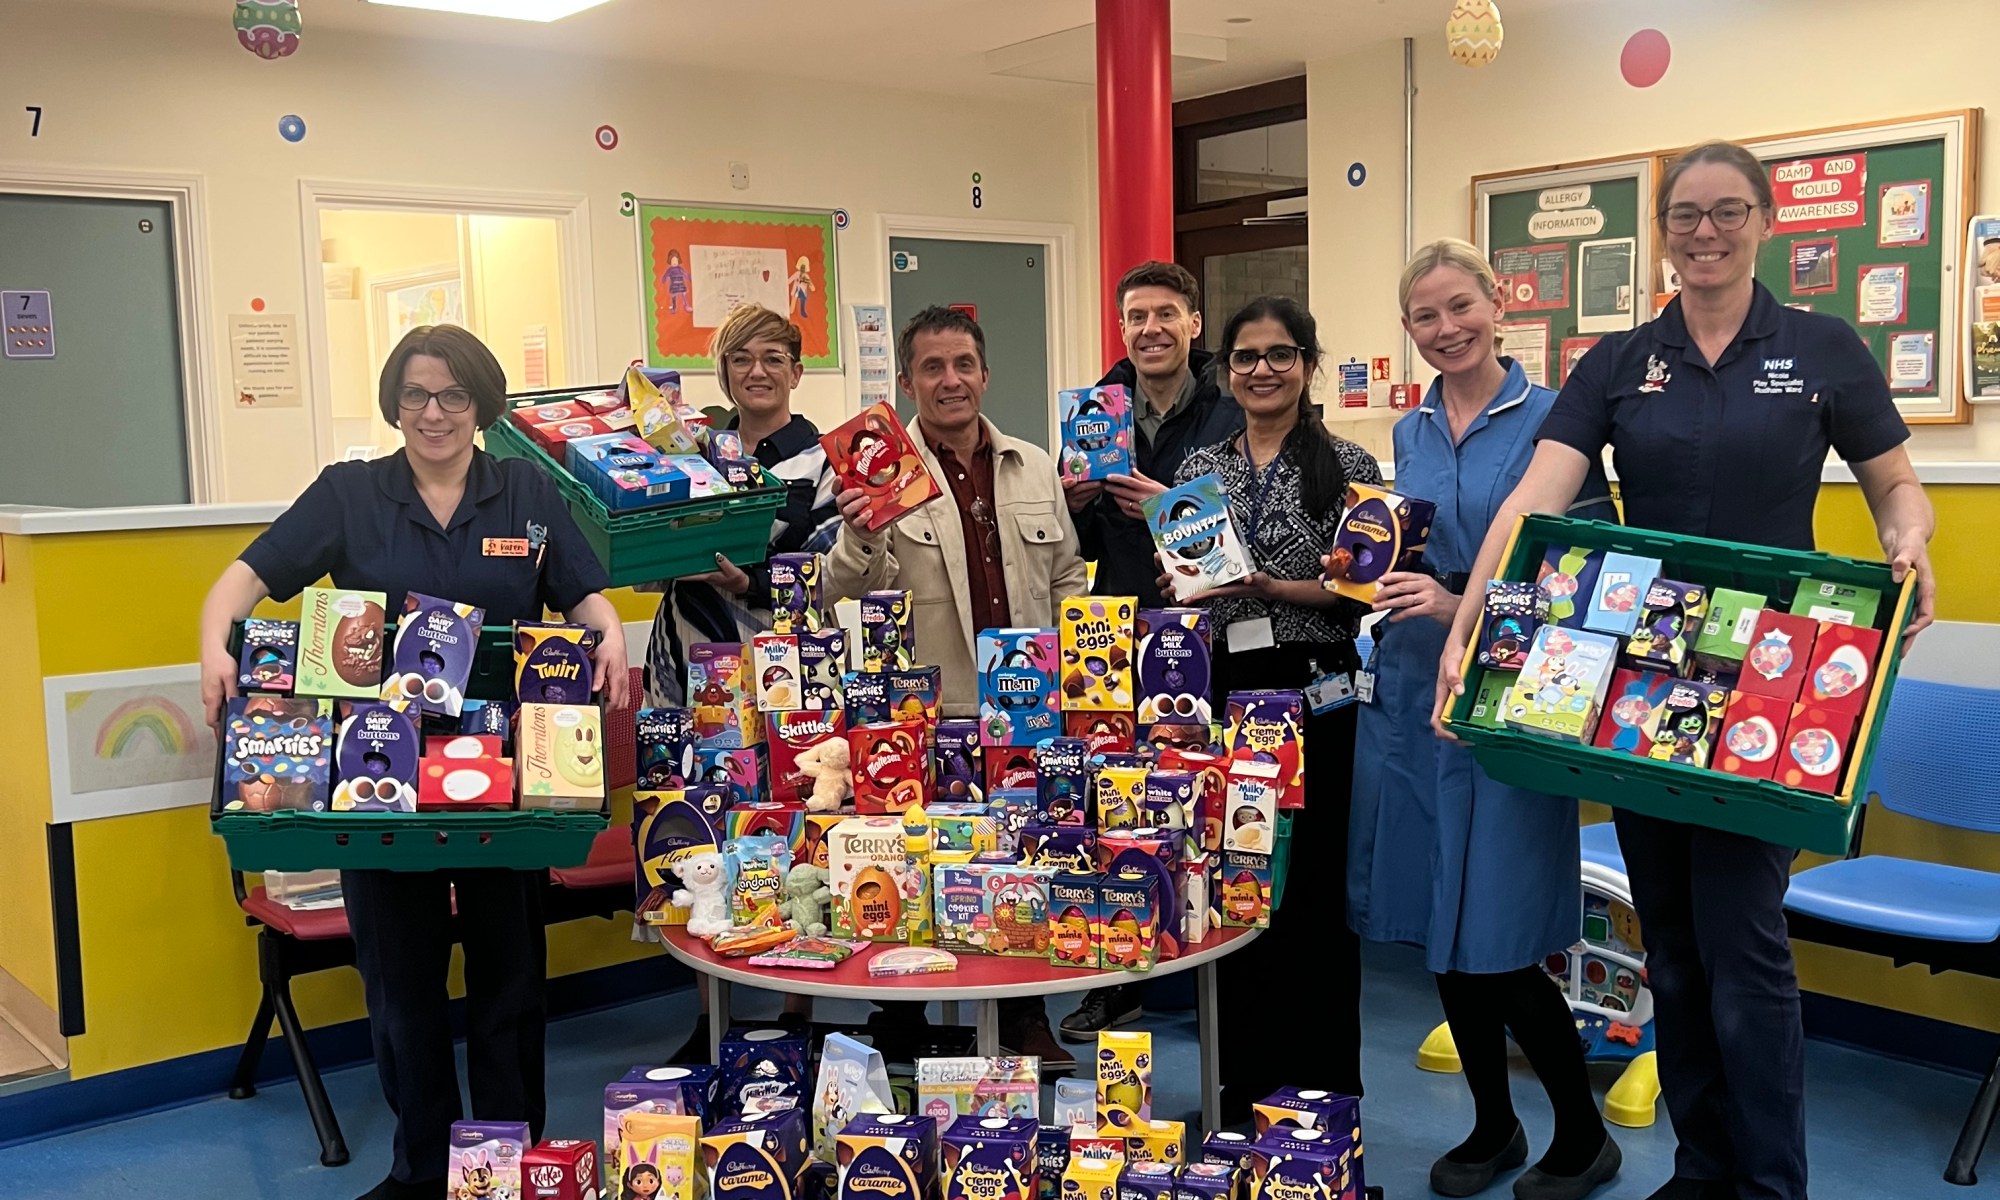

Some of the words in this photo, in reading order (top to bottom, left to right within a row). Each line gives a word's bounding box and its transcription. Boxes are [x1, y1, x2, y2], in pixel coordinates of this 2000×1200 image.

[26, 106, 42, 136] 7
[1777, 167, 1812, 180] DAMP
[1826, 159, 1854, 174] AND
[1795, 182, 1840, 196] MOULD
[973, 186, 981, 208] 8
[1545, 192, 1583, 205] ALLERGY
[1780, 202, 1856, 219] AWARENESS
[1533, 216, 1597, 230] INFORMATION
[20, 296, 30, 310] 7
[1764, 359, 1793, 370] NHS
[856, 439, 887, 476] Maltesers
[1162, 514, 1218, 545] BOUNTY
[1349, 520, 1388, 537] Caramel
[772, 574, 795, 584] Freddo
[1646, 594, 1674, 607] Freddo
[428, 616, 454, 628] DAIRY
[862, 613, 885, 623] Freddo
[302, 591, 329, 676] Thorntons
[428, 624, 449, 633] MILK
[1075, 619, 1111, 637] Mini
[418, 627, 458, 644] buttons
[1076, 632, 1116, 650] eggs
[1160, 635, 1185, 643] DAIRY
[764, 645, 789, 654] Milky
[1163, 641, 1182, 649] MILK
[542, 648, 569, 657] Cadbury
[769, 653, 784, 662] bar
[1155, 648, 1192, 657] buttons
[530, 659, 580, 680] Twirl
[1668, 694, 1698, 709] Freddo
[365, 717, 393, 726] DAIRY
[367, 723, 388, 731] MILK
[358, 730, 400, 740] buttons
[779, 720, 834, 740] Skittles
[1249, 728, 1281, 738] creme
[526, 705, 552, 779] Thorntons
[1090, 735, 1118, 753] altesers
[1254, 735, 1276, 745] egg
[867, 754, 902, 777] Maltesers
[1100, 788, 1121, 798] Mini
[1238, 783, 1265, 795] Milky
[1100, 797, 1123, 806] eggs
[1242, 793, 1261, 801] bar
[661, 851, 692, 866] Flak
[870, 854, 906, 862] ORANG
[991, 878, 1000, 888] 6
[863, 902, 889, 913] mini
[948, 905, 978, 913] COOKIES
[863, 911, 891, 922] eggs
[1058, 930, 1082, 939] minis
[1108, 934, 1133, 943] minis
[921, 1063, 979, 1074] CRYSTAL
[1100, 1060, 1123, 1071] Mini
[1101, 1070, 1127, 1080] eggs
[928, 1108, 948, 1116] 4000
[1083, 1150, 1112, 1159] Milky
[1129, 1149, 1152, 1159] Mini
[726, 1162, 756, 1172] Cadbury
[1040, 1156, 1064, 1167] TIES
[859, 1163, 891, 1175] Cadbury
[532, 1167, 562, 1187] KitKat
[721, 1174, 769, 1186] Caramel
[964, 1176, 1002, 1188] creme
[852, 1178, 902, 1188] Caramel
[971, 1185, 996, 1196] egg
[1064, 1191, 1087, 1200] Mini
[1274, 1187, 1311, 1199] creme
